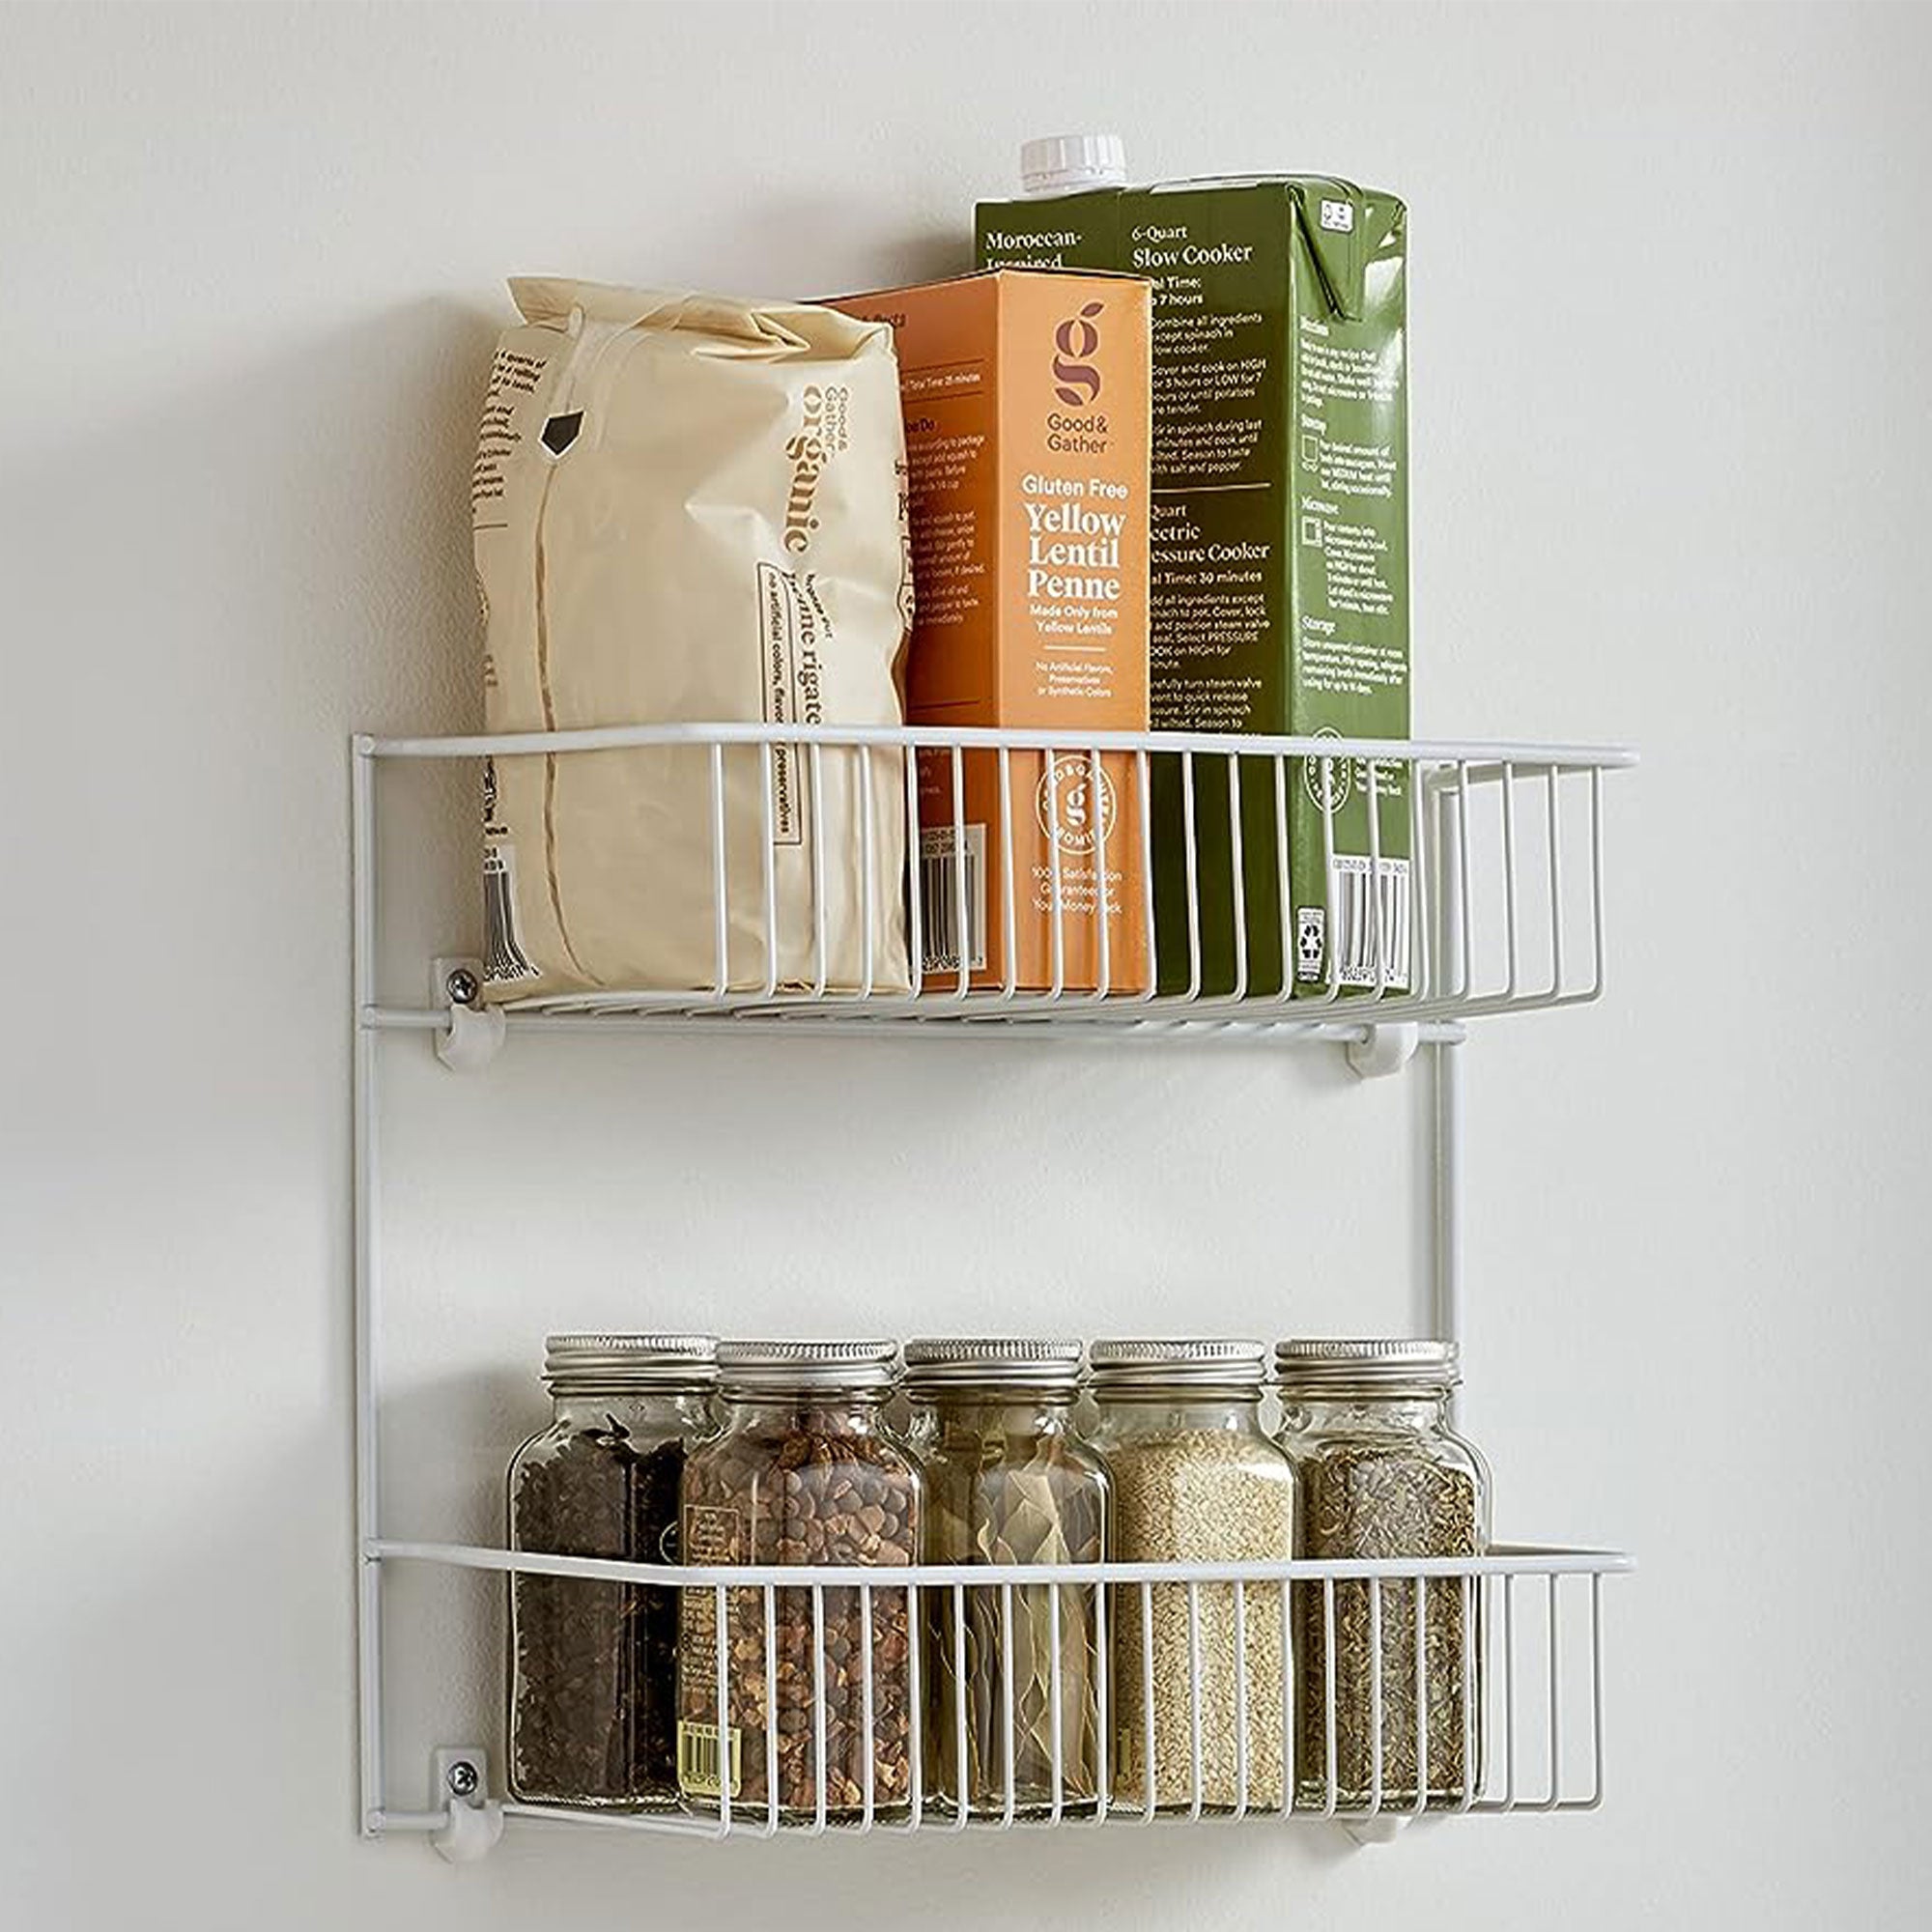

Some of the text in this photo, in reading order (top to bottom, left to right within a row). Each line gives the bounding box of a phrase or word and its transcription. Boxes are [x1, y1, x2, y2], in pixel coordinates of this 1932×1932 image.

[985, 229, 1082, 250] Moroccan-
[1131, 224, 1188, 242] 6-Quart
[1132, 242, 1253, 269] Slow Cooker
[1167, 275, 1202, 289] Time:
[1169, 293, 1204, 306] hours
[1210, 312, 1263, 328] ingredients
[1153, 326, 1235, 343] xcept spinach in
[1153, 343, 1172, 355] low
[1180, 362, 1199, 375] and
[1201, 360, 1225, 374] cook
[1226, 362, 1238, 372] on
[1240, 357, 1266, 369] HIGH
[1151, 380, 1164, 388] or
[1173, 376, 1202, 388] hours
[1202, 377, 1214, 387] or
[1214, 373, 1239, 386] LOW
[1240, 372, 1255, 384] for
[1151, 392, 1177, 402] ours
[1214, 386, 1256, 401] potatoes
[824, 385, 838, 451] Gather
[1177, 422, 1213, 437] spinach
[1214, 419, 1244, 434] during
[1245, 418, 1263, 430] last
[1047, 434, 1109, 454] Gather
[1195, 435, 1213, 446] and
[1214, 436, 1236, 445] cook
[1238, 432, 1259, 444] until
[1151, 449, 1179, 462] ilted.
[1181, 448, 1215, 461] Season
[1216, 446, 1227, 459] to
[783, 384, 828, 554] organic
[1151, 462, 1168, 474] ith
[1188, 460, 1207, 472] and
[1022, 473, 1128, 499] Gluten Free
[1024, 502, 1126, 536] Yellow
[1151, 504, 1187, 521] Quart
[1151, 522, 1202, 541] ectric
[1029, 534, 1120, 568] Lentil
[1151, 541, 1271, 563] essure Cooker
[1027, 569, 1121, 601] Penne
[1163, 571, 1197, 584] Time:
[1216, 569, 1263, 583] minutes
[1151, 594, 1164, 607] dd
[1178, 593, 1230, 608] ingredients
[770, 590, 785, 641] artificial
[1030, 604, 1119, 619] Made Only from
[1151, 608, 1179, 618] inach
[1245, 605, 1266, 617] lock
[1036, 619, 1113, 635] Yellow Lentils
[1150, 645, 1173, 657] OOK
[1174, 646, 1187, 657] on
[1188, 643, 1215, 657] HIGH
[772, 643, 784, 686] colors,
[797, 649, 824, 724] rigate
[1151, 678, 1182, 691] refully
[774, 687, 786, 724] flavor
[775, 748, 791, 834] preservatives
